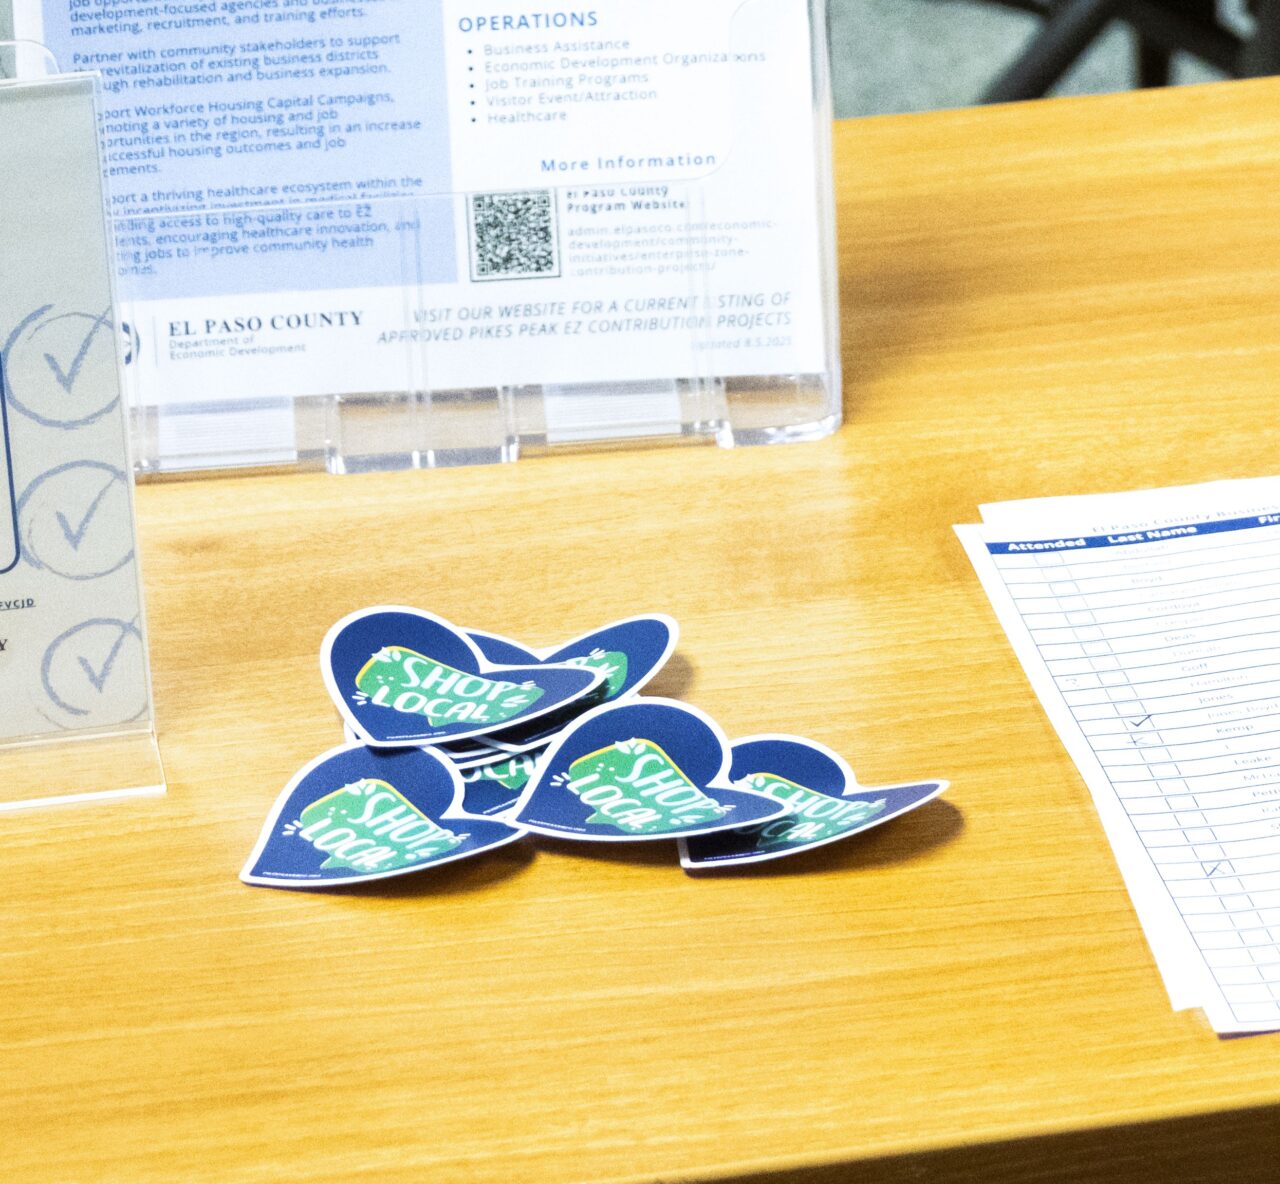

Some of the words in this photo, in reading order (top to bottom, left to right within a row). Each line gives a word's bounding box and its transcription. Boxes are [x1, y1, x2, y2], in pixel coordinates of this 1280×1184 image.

[457, 10, 597, 33] OPERATIONS
[540, 158, 589, 172] More
[597, 154, 715, 169] Information
[168, 322, 197, 337] EL
[204, 316, 262, 334] PASO
[270, 311, 363, 331] COUNTY
[1008, 537, 1086, 552] Attended
[1107, 531, 1144, 545] Last
[1147, 525, 1198, 540] Name
[401, 656, 518, 701] SHOP
[372, 686, 489, 721] LOCAL
[567, 774, 662, 828] LOCAL
[615, 754, 720, 819] SHOP
[347, 792, 454, 849] SHOP
[299, 818, 397, 867] LOCAL
